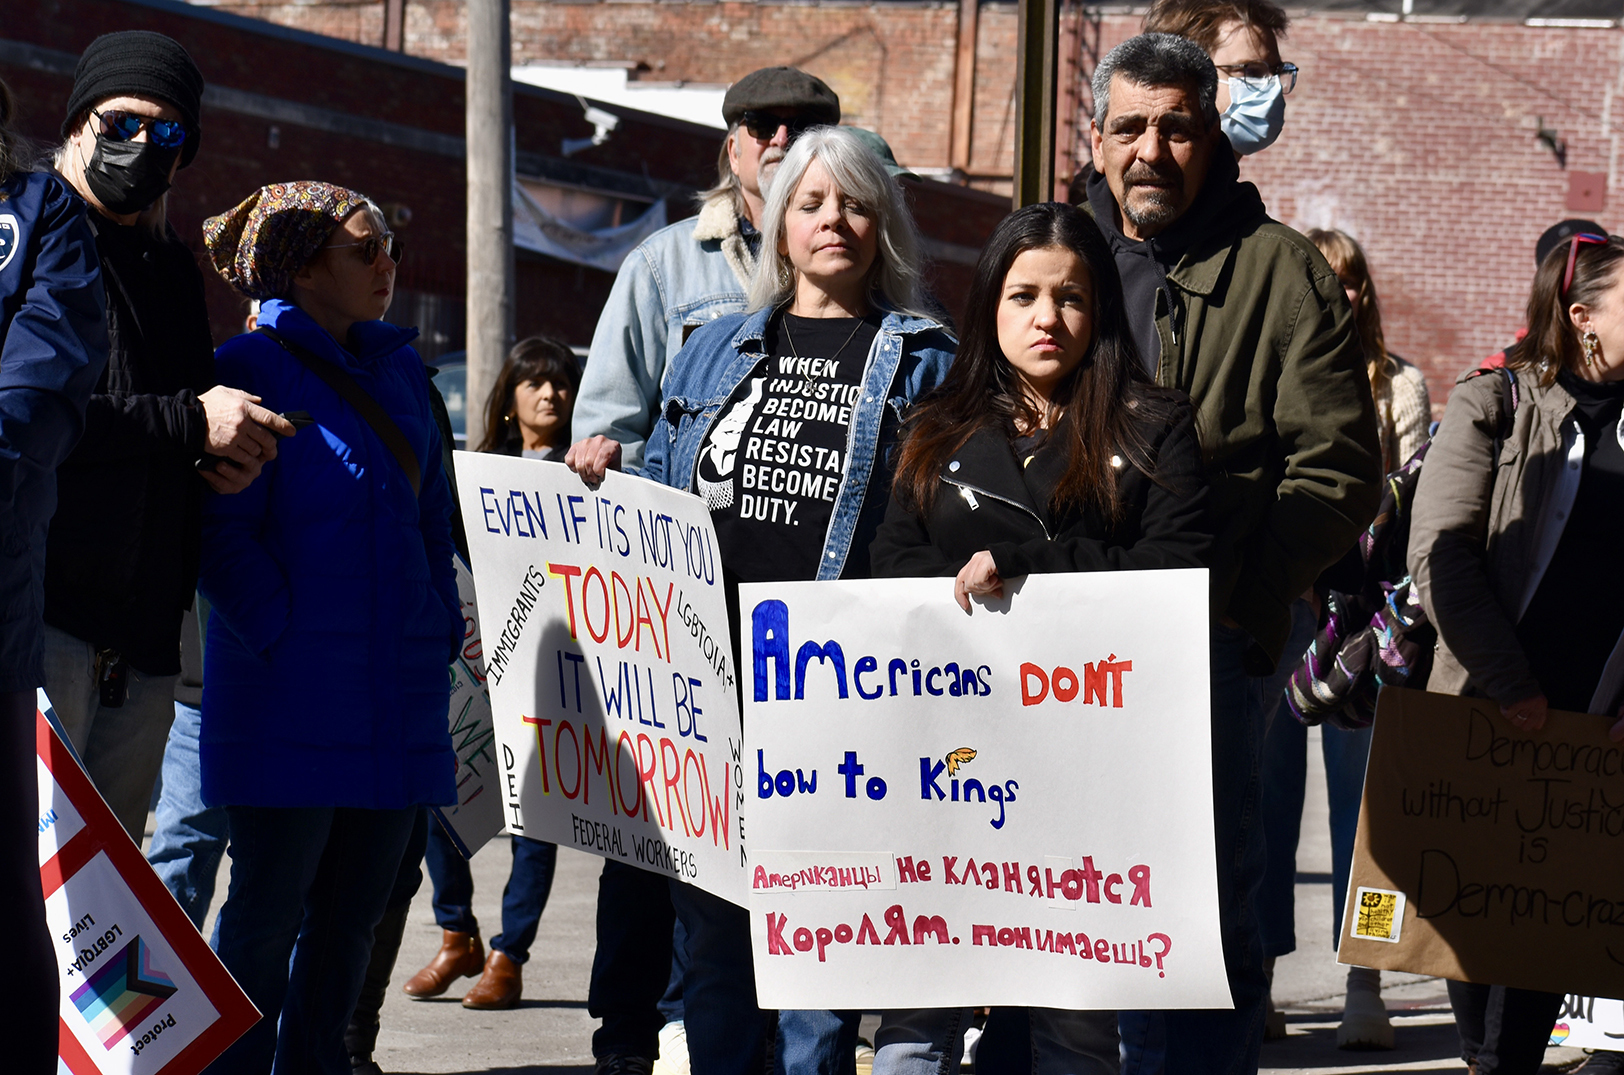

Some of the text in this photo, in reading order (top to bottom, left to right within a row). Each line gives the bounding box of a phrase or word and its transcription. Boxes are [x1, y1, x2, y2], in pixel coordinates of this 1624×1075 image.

[779, 356, 840, 378] WHEN
[745, 436, 846, 475] RESISTA
[752, 416, 803, 439] LAW
[480, 487, 714, 586] EVEN IF ITS NOT YOU
[740, 494, 799, 526] DUTY.
[485, 565, 545, 686] IMMIGRANTS
[547, 561, 674, 664] TODAY
[677, 590, 734, 687] LGBTQIA+
[752, 599, 1132, 708] Americans DON'T
[557, 650, 708, 743] IT WILL BE
[502, 743, 524, 830] DEI
[521, 715, 729, 850] TOMORROW
[757, 749, 1019, 829] bow to Kings
[1402, 779, 1508, 824] without
[571, 813, 697, 878] FEDERAL WORKERS
[1519, 835, 1549, 864] is
[62, 913, 96, 943] Lives
[67, 923, 123, 977] LGBTQIA+
[130, 1013, 177, 1056] Protect
